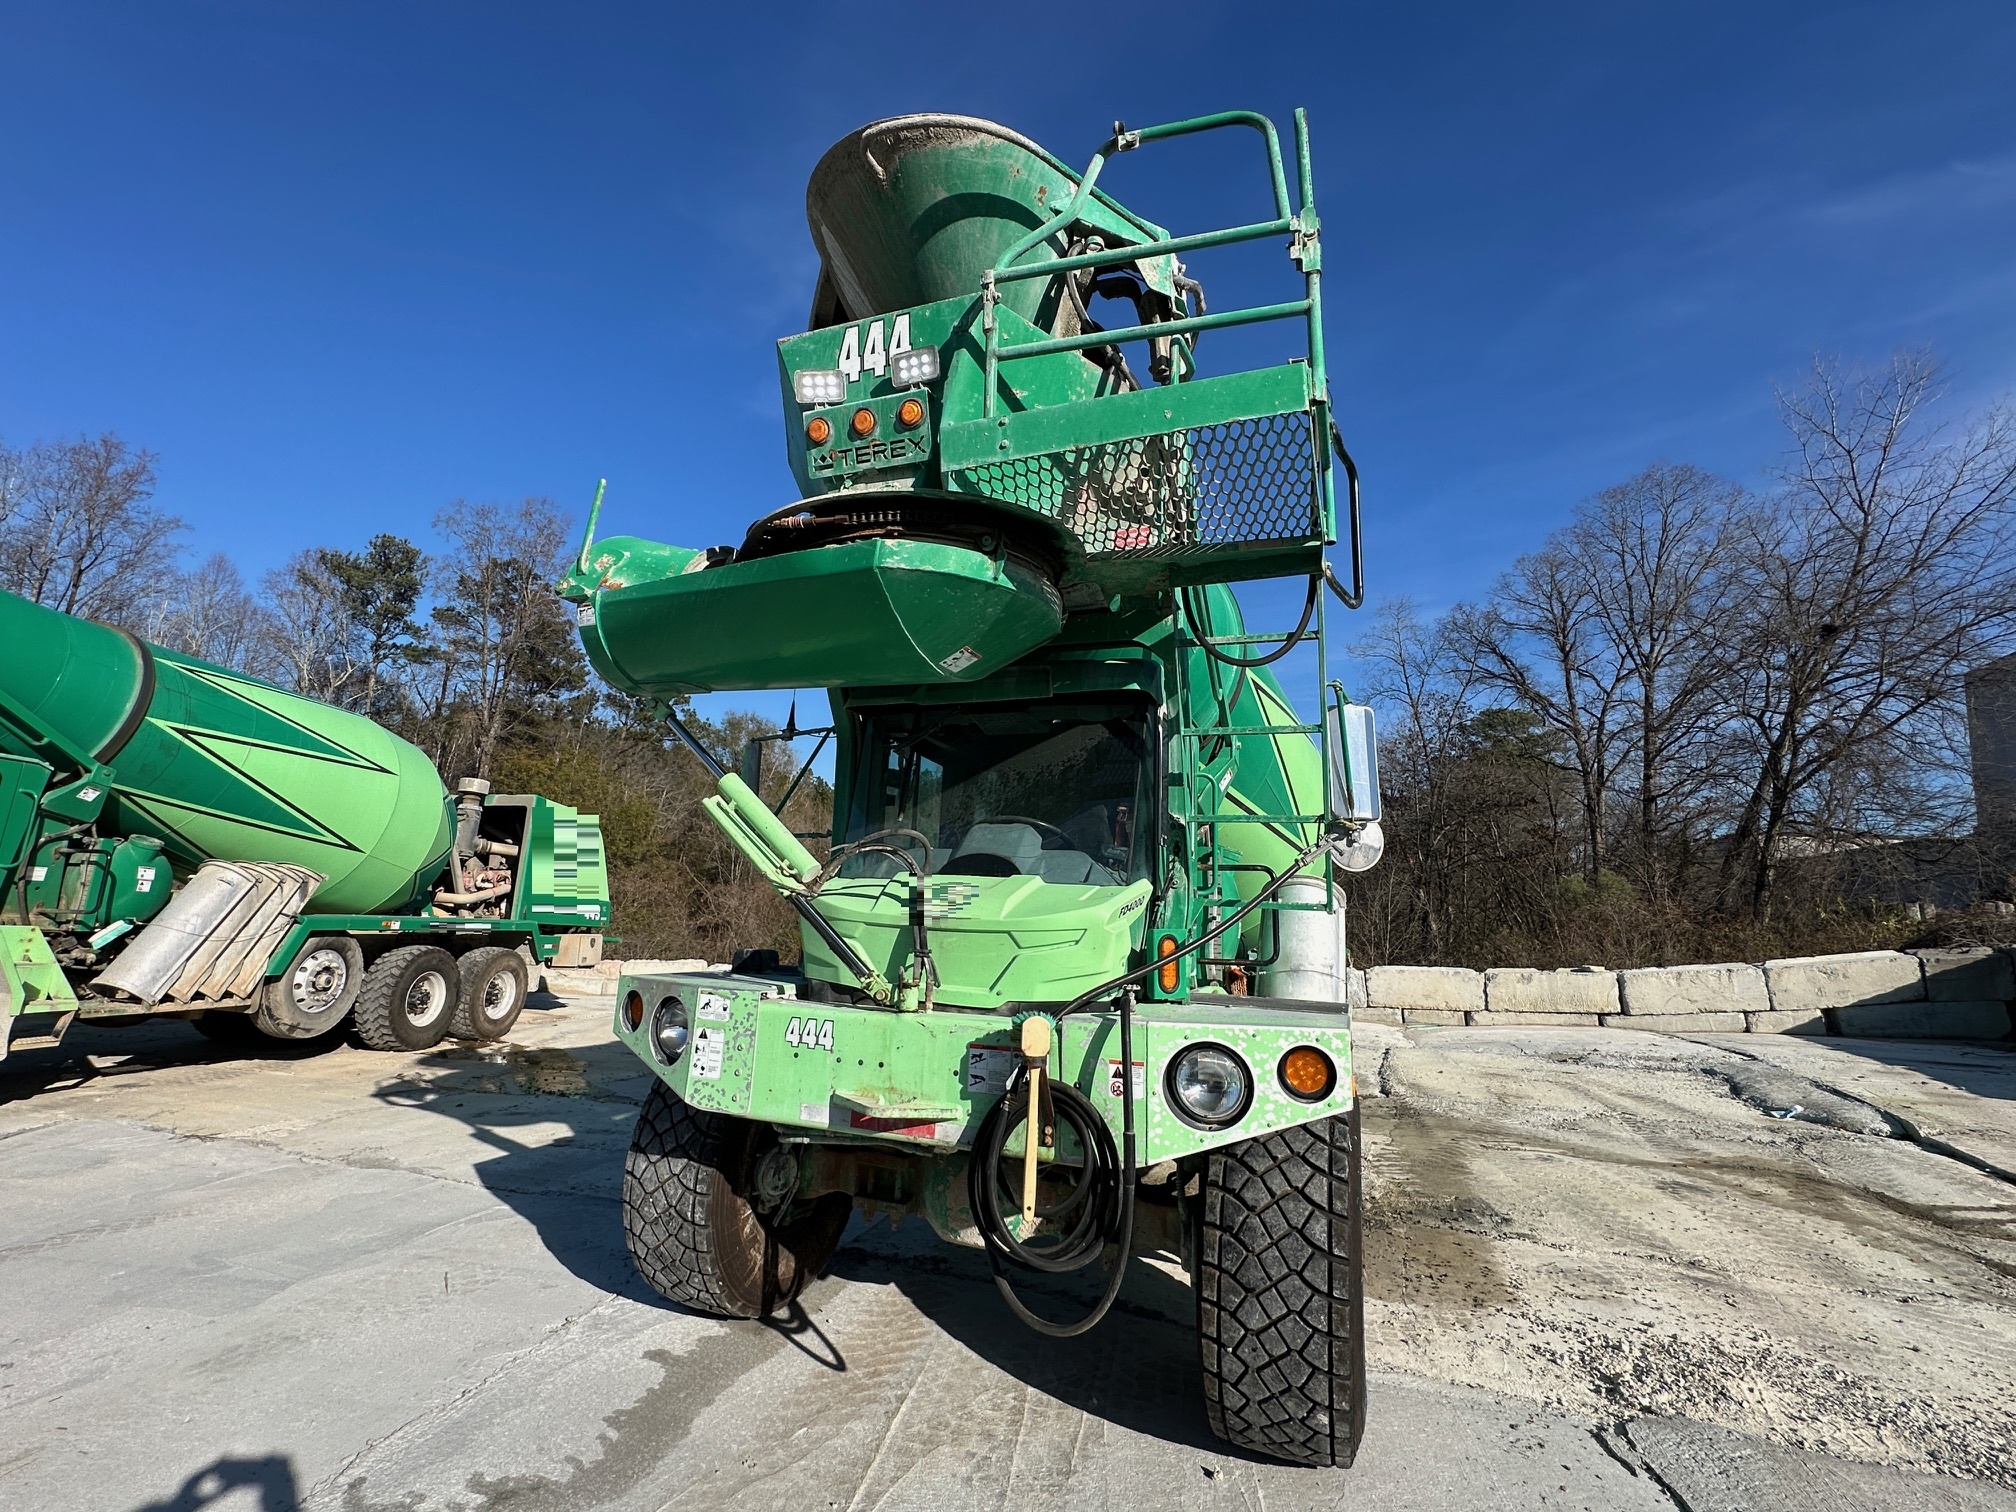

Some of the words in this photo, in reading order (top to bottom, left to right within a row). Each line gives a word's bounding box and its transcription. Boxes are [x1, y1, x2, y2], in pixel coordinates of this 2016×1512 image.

[837, 313, 912, 382] 444
[838, 436, 926, 466] TEREX
[785, 1017, 834, 1050] 444
